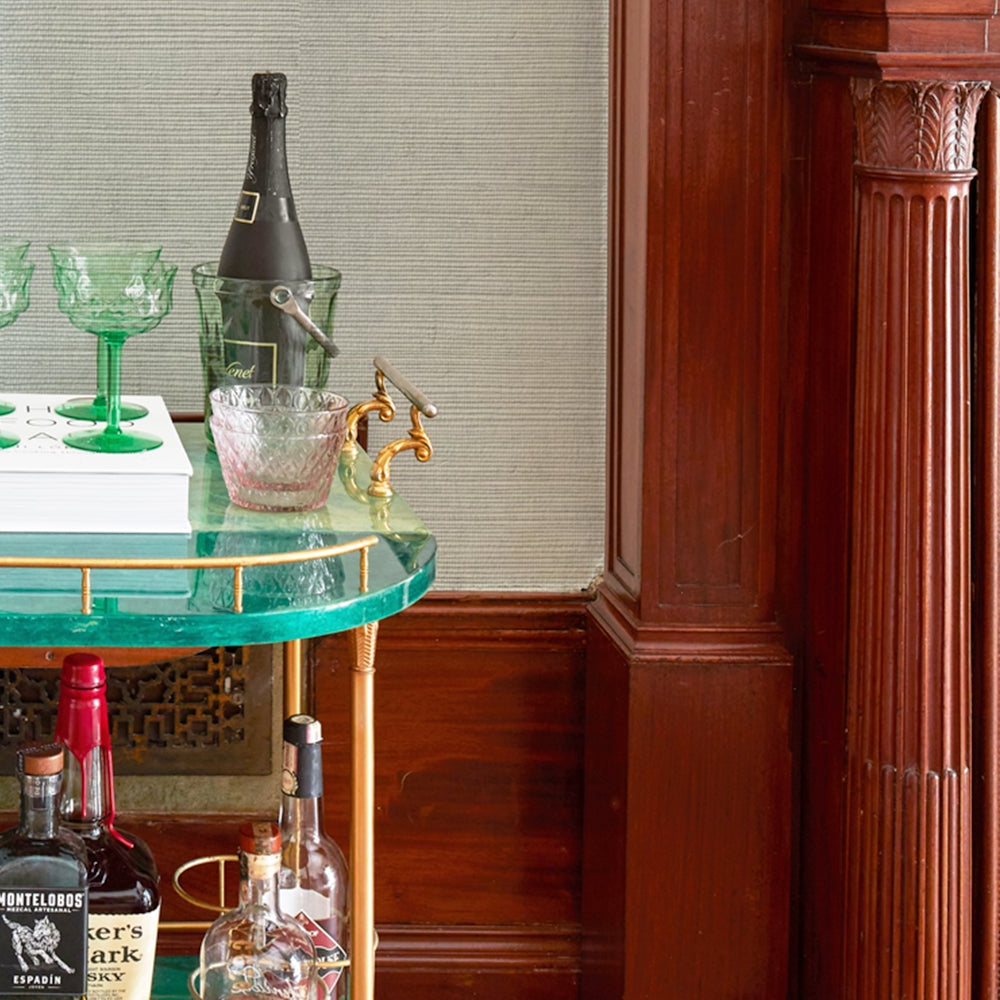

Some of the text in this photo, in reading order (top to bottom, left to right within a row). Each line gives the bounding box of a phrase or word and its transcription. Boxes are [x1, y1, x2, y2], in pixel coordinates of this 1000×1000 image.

[90, 945, 141, 964] ark
[13, 974, 62, 985] ESPADÍN
[87, 971, 126, 982] SKY
